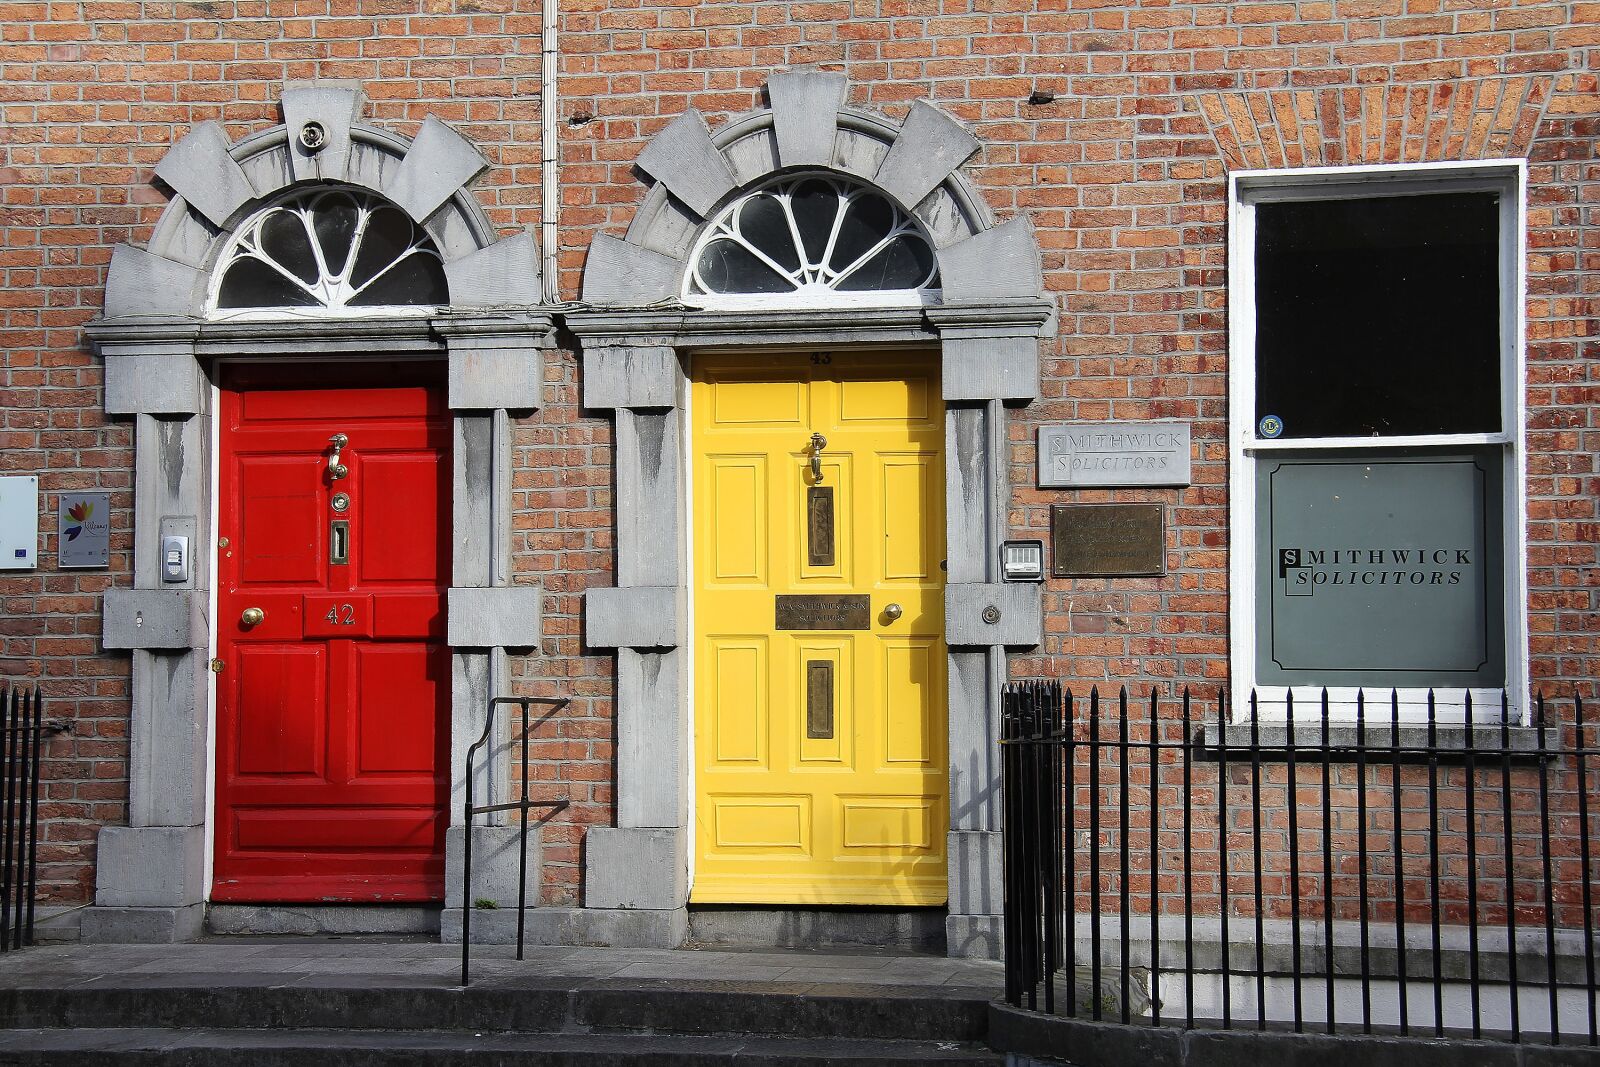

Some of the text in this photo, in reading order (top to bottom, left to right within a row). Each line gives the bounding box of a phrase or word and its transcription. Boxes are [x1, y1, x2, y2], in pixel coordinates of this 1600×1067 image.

[810, 351, 832, 365] 43
[1051, 433, 1182, 452] SMITHWICK
[1057, 456, 1168, 471] SOLICITORS
[1283, 549, 1471, 565] SMITHWICK
[1295, 571, 1461, 585] SOLICITORS
[324, 603, 356, 625] 42
